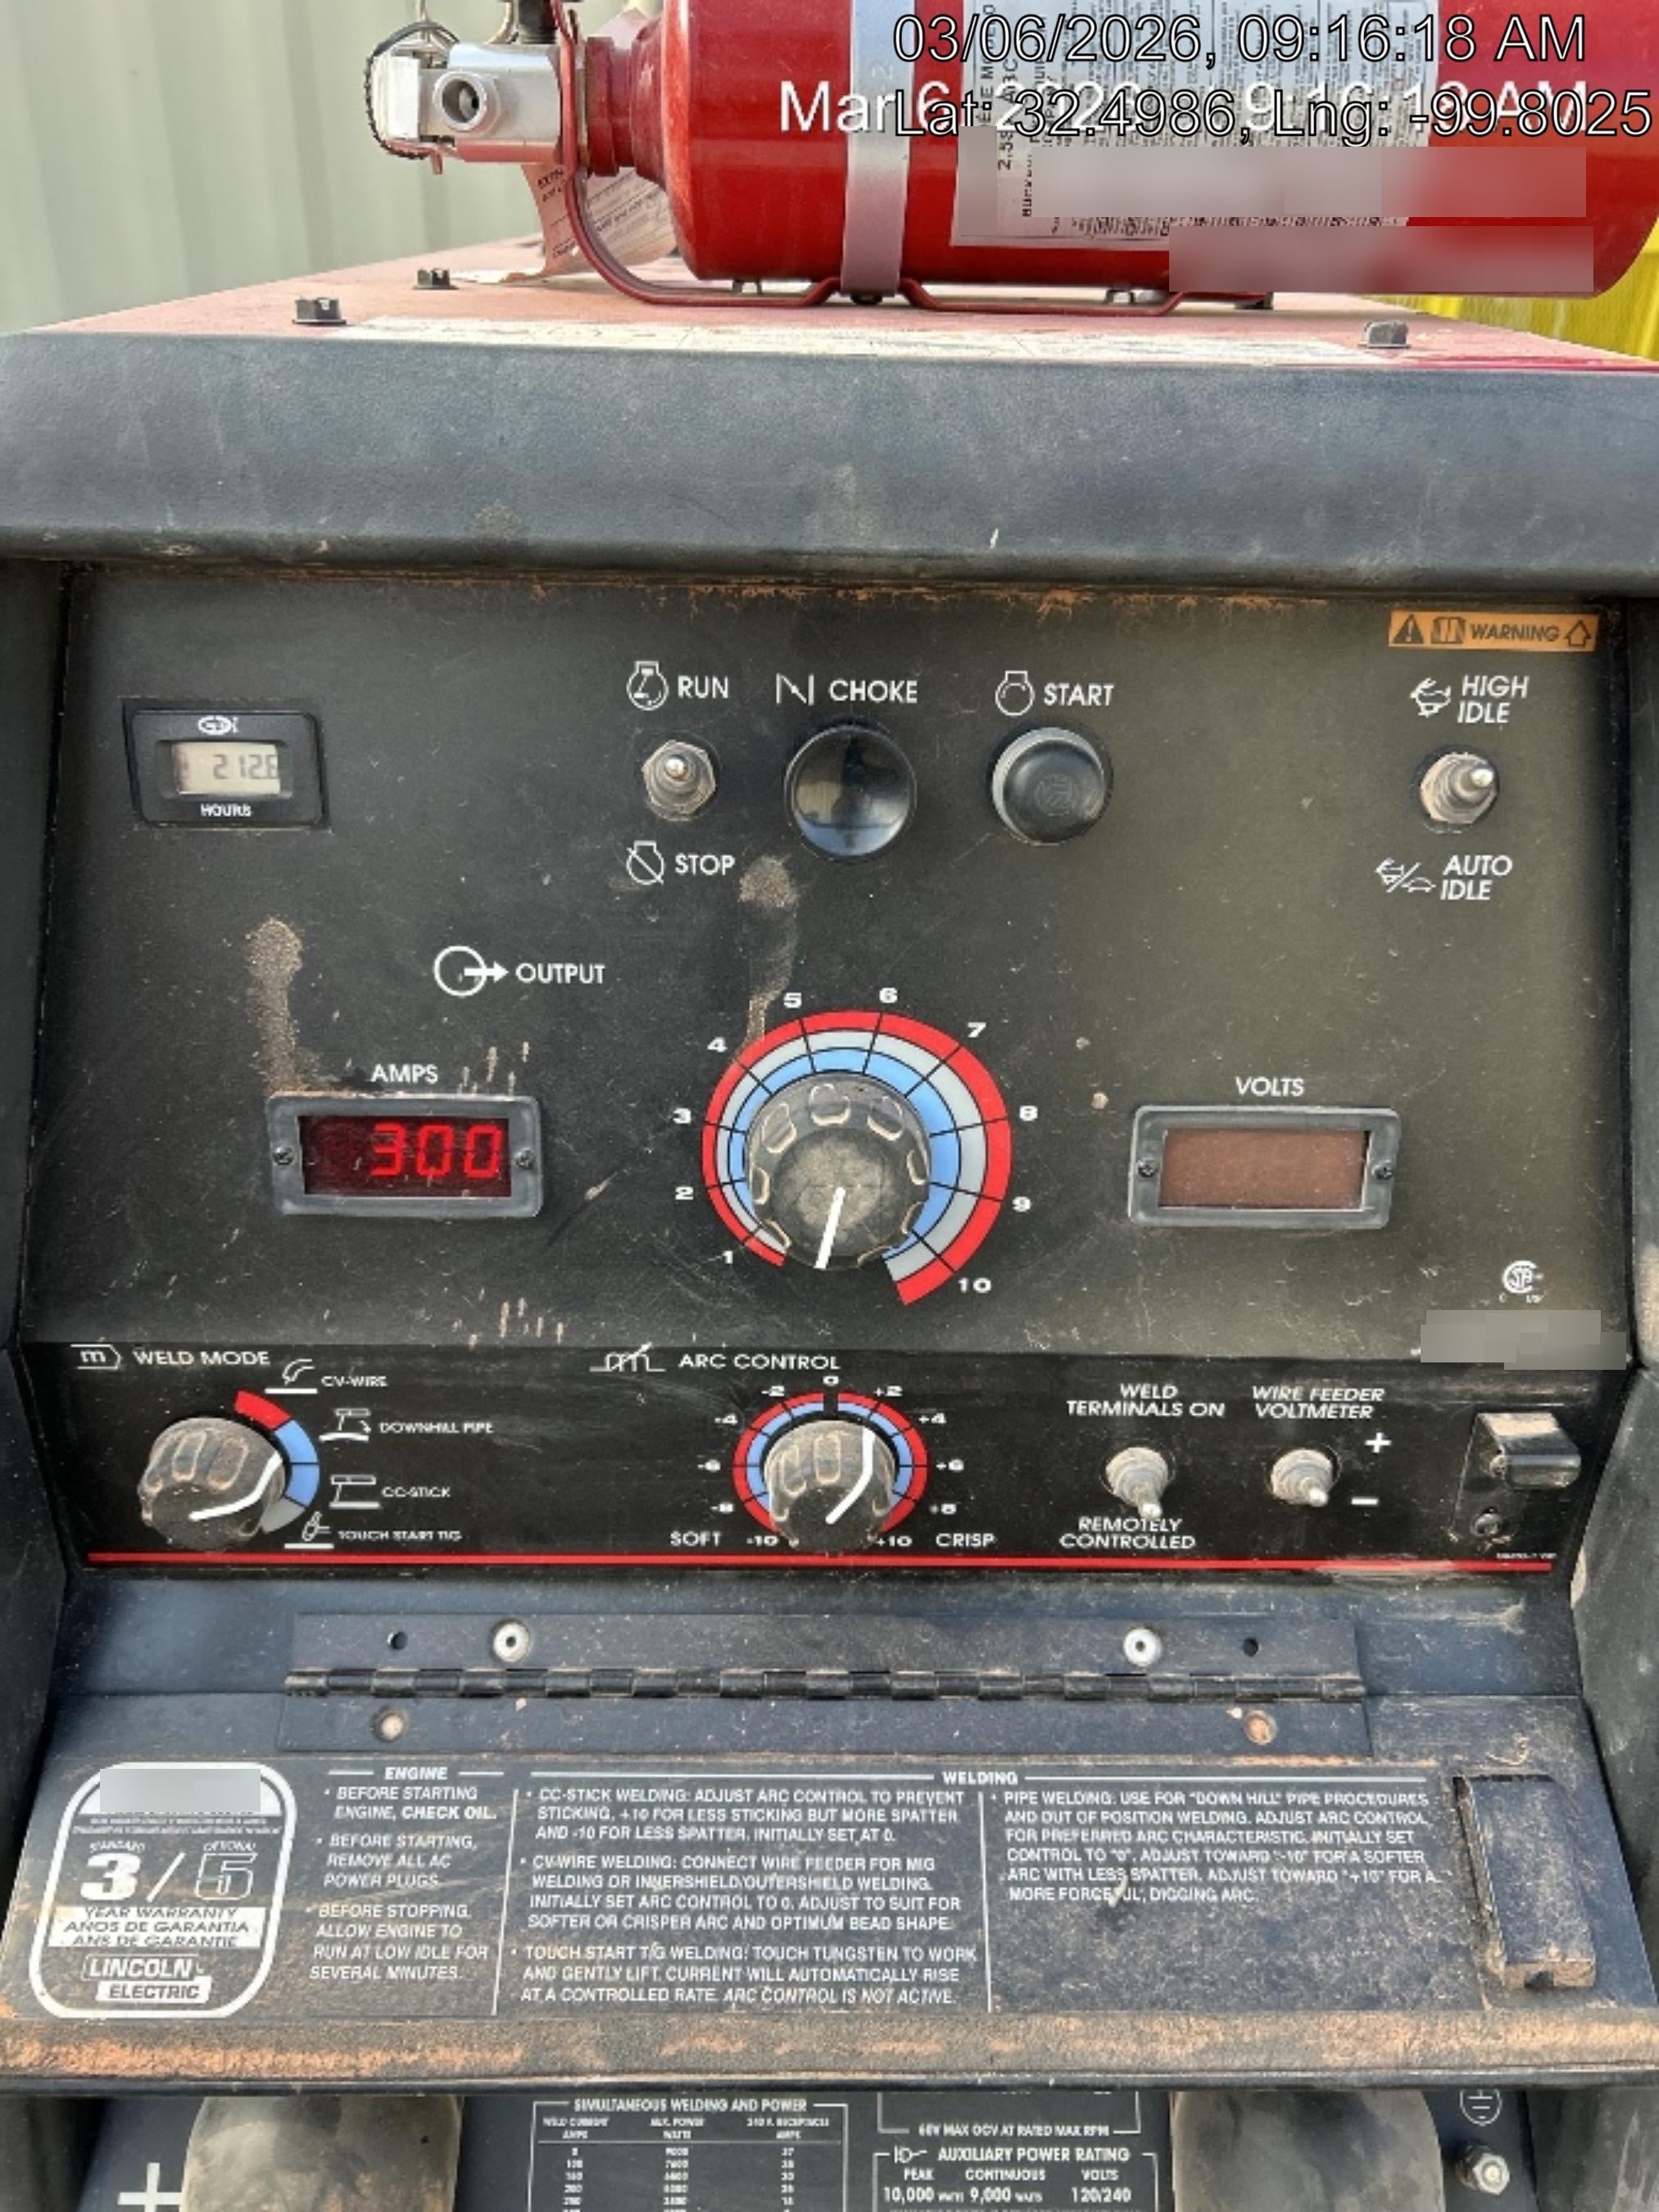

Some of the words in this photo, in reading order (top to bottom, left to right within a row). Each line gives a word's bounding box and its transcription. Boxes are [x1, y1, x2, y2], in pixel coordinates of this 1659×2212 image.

[1471, 623, 1559, 641] WARNING
[678, 676, 729, 698] RUN
[829, 679, 918, 703] CHOKE
[1462, 675, 1530, 698] HIGH
[1043, 683, 1114, 707] START
[1457, 700, 1511, 723] IDLE
[201, 803, 252, 817] HOURS
[675, 854, 736, 876] STOP
[1443, 854, 1513, 877] AUTO
[1440, 879, 1493, 900] IDLE
[515, 963, 605, 984] OUTPUT
[783, 992, 802, 1009] 5
[879, 987, 898, 1004] 6
[967, 1022, 986, 1038] 7
[707, 1037, 727, 1053] 4
[370, 1063, 439, 1084] AMPS
[1235, 1077, 1304, 1097] VOLTS
[673, 1108, 691, 1124] 3
[1019, 1105, 1038, 1122] 8
[371, 1122, 503, 1178] 300
[675, 1185, 694, 1201] 2
[1013, 1197, 1031, 1213] 9
[722, 1251, 733, 1265] 1
[958, 1278, 992, 1293] 10
[133, 1350, 194, 1366] WELD
[201, 1350, 270, 1367] MODE
[678, 1354, 727, 1370] ARC
[734, 1354, 840, 1371] CONTROL
[321, 1375, 388, 1388] CV-WIRE
[823, 1376, 839, 1386] 0
[762, 1386, 785, 1397] -2
[875, 1386, 903, 1398] +2
[1119, 1383, 1177, 1399] WELD
[1252, 1385, 1304, 1402] WIRE
[1308, 1386, 1385, 1403] FEEDER
[1067, 1399, 1185, 1416] TERMINALS
[1190, 1401, 1225, 1417] ON
[1255, 1402, 1374, 1419] VOLTMETER
[714, 1413, 737, 1425] -4
[918, 1413, 947, 1425] +4
[379, 1421, 458, 1434] DOWNHILL
[463, 1421, 493, 1434] PIPE
[697, 1459, 721, 1472] -6
[936, 1459, 964, 1472] +6
[382, 1485, 451, 1498] CC-STICK
[1078, 1516, 1182, 1533] REMOTELY
[338, 1530, 388, 1541] TOUCH
[392, 1530, 434, 1541] START
[437, 1530, 462, 1541] TIG
[670, 1531, 722, 1546] SOFT
[746, 1535, 778, 1547] -10
[877, 1535, 912, 1548] +10
[936, 1532, 995, 1548] CRISP
[1059, 1533, 1196, 1550] CONTROLLED
[384, 1766, 447, 1780] ENGINE
[942, 1771, 1018, 1785] WELDING
[336, 1787, 398, 1800] BEFORE
[402, 1787, 478, 1800] STARTING
[540, 1789, 611, 1802] CC-STICK
[695, 1790, 753, 1802] ADJUST
[757, 1790, 789, 1802] ARC
[794, 1791, 867, 1803] CONTROL
[871, 1791, 892, 1803] TO
[896, 1791, 964, 1803] PREVENT
[401, 1806, 460, 1820] CHECK
[464, 1806, 497, 1820] OIL.
[1005, 1811, 1036, 1824] AND
[1041, 1811, 1072, 1824] OUT
[1076, 1811, 1097, 1824] OF
[1100, 1811, 1173, 1824] POSITION
[1256, 1811, 1312, 1824] ADJUST
[1317, 1811, 1350, 1824] ARC
[329, 1834, 392, 1847] BEFORE
[326, 1853, 392, 1867] REMOVE
[397, 1854, 425, 1868] ALL
[429, 1854, 452, 1868] AC
[533, 1856, 596, 1869] CV-WIRE
[601, 1856, 677, 1870] WELDING:
[681, 1856, 757, 1870] CONNECT
[762, 1857, 801, 1870] WIRE
[805, 1857, 865, 1870] FEEDER
[870, 1858, 901, 1871] FOR
[906, 1858, 936, 1871] MIG
[80, 1852, 142, 1901] 3
[194, 1852, 258, 1901] 5
[324, 1874, 381, 1888] POWER
[85, 1906, 130, 1918] YEAR
[137, 1906, 238, 1919] WARRANTY
[319, 1904, 383, 1918] BEFORE
[125, 1921, 150, 1933] DE
[154, 1921, 249, 1933] GARANTIA
[316, 1924, 371, 1938] ALLOW
[376, 1924, 435, 1938] ENGINE
[441, 1924, 463, 1938] TO
[73, 1936, 111, 1947] ANS
[117, 1936, 140, 1947] DE
[144, 1936, 238, 1947] GARANTIE
[313, 1944, 347, 1958] RUN
[351, 1944, 370, 1958] AT
[375, 1944, 410, 1958] LOW
[415, 1945, 450, 1959] IDLE
[455, 1945, 489, 1959] FOR
[525, 1946, 581, 1960] TOUCH
[587, 1947, 636, 1960] START
[640, 1947, 667, 1960] TIG
[753, 1947, 808, 1961] TOUCH
[813, 1948, 898, 1962] TUNGSTEN
[903, 1948, 923, 1962] TO
[929, 1949, 977, 1963] WORK
[89, 1957, 193, 1978] LINCOLN
[309, 1965, 381, 1979] SEVERAL
[108, 1984, 200, 1999] ELECTRIC
[574, 2099, 667, 2112] SIMULTANEOUS
[671, 2100, 728, 2113] WELDING
[731, 2100, 758, 2113] AND
[761, 2100, 807, 2113] POWER
[938, 2147, 1013, 2161] AUXILIARY
[1017, 2147, 1070, 2161] POWER
[1075, 2147, 1130, 2161] RATING
[904, 2169, 934, 2181] PEAK
[965, 2169, 1045, 2181] CONTINUOUS
[1081, 2169, 1119, 2181] VOLTS
[883, 2187, 935, 2204] 10,000
[970, 2187, 1011, 2204] 9,000
[1072, 2187, 1132, 2202] 120/240
